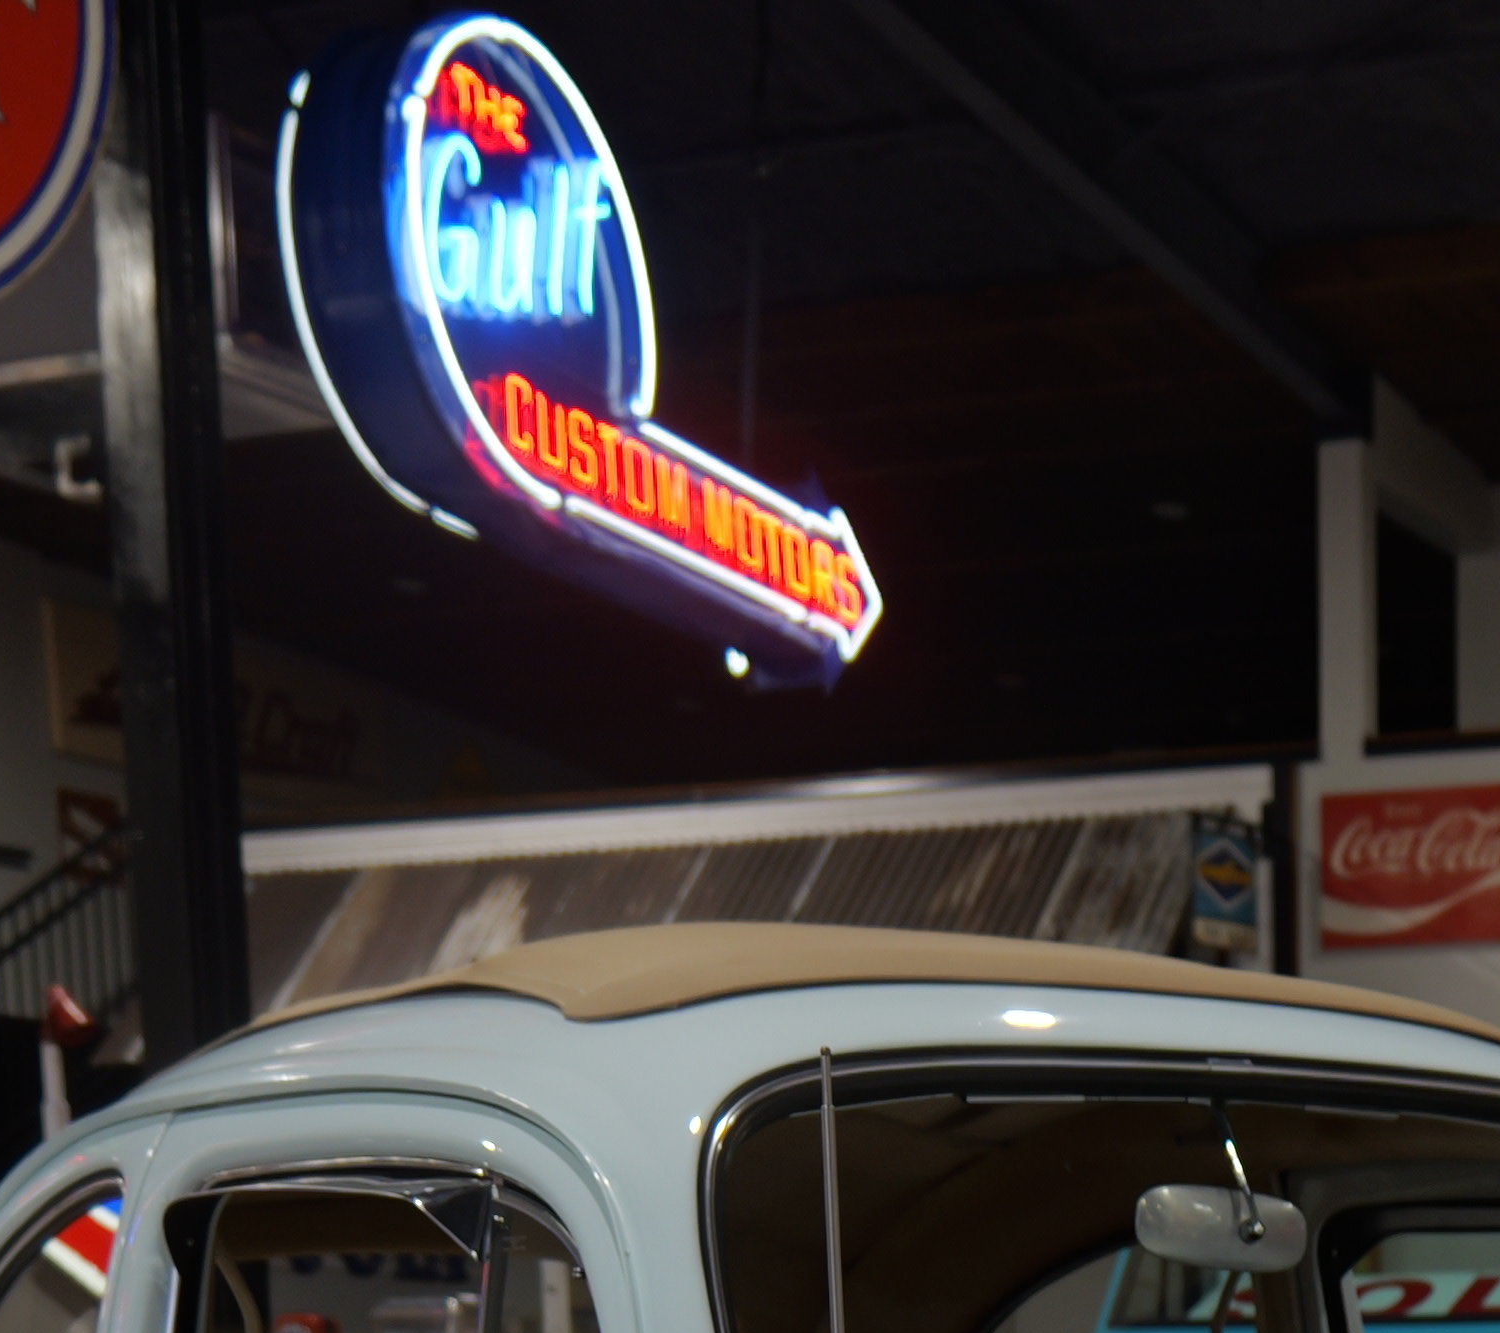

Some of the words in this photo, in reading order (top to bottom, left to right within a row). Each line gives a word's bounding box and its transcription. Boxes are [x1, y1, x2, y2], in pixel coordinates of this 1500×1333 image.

[450, 62, 529, 153] THE
[422, 131, 612, 317] Gulf
[503, 372, 690, 532] CUSTOM
[701, 476, 862, 624] MOTORS
